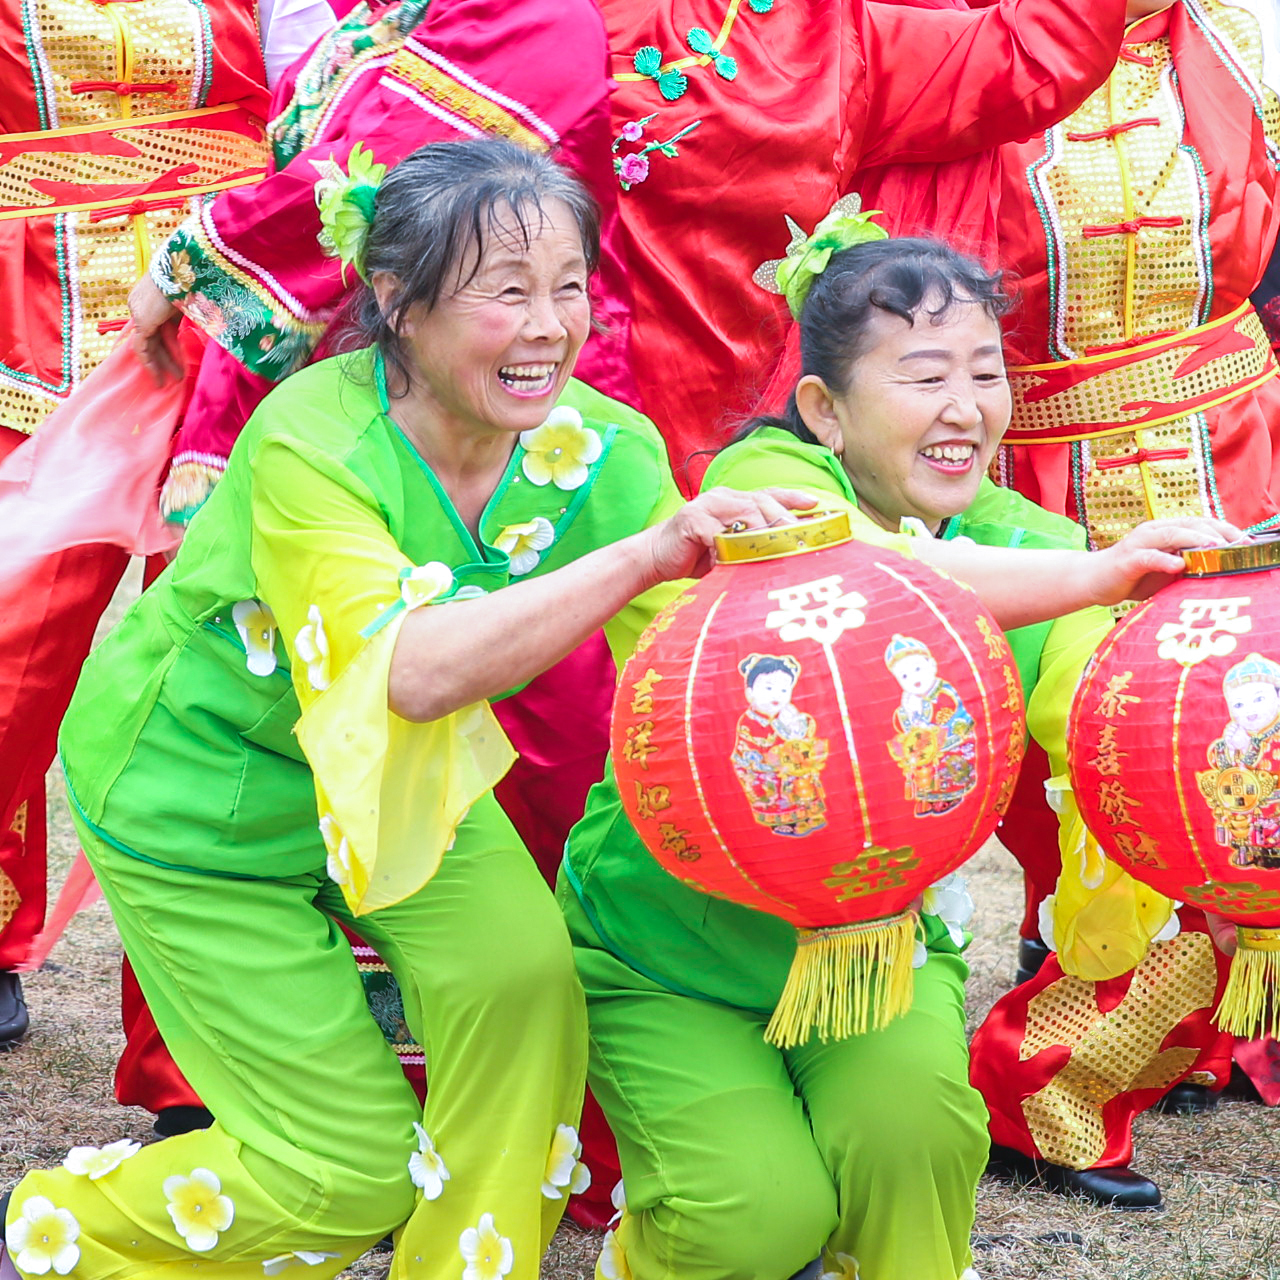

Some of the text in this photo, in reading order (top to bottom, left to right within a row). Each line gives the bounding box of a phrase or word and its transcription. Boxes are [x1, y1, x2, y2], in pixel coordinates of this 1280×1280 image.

[622, 667, 702, 862] 吉祥如意
[1087, 671, 1168, 869] 恭喜發財
